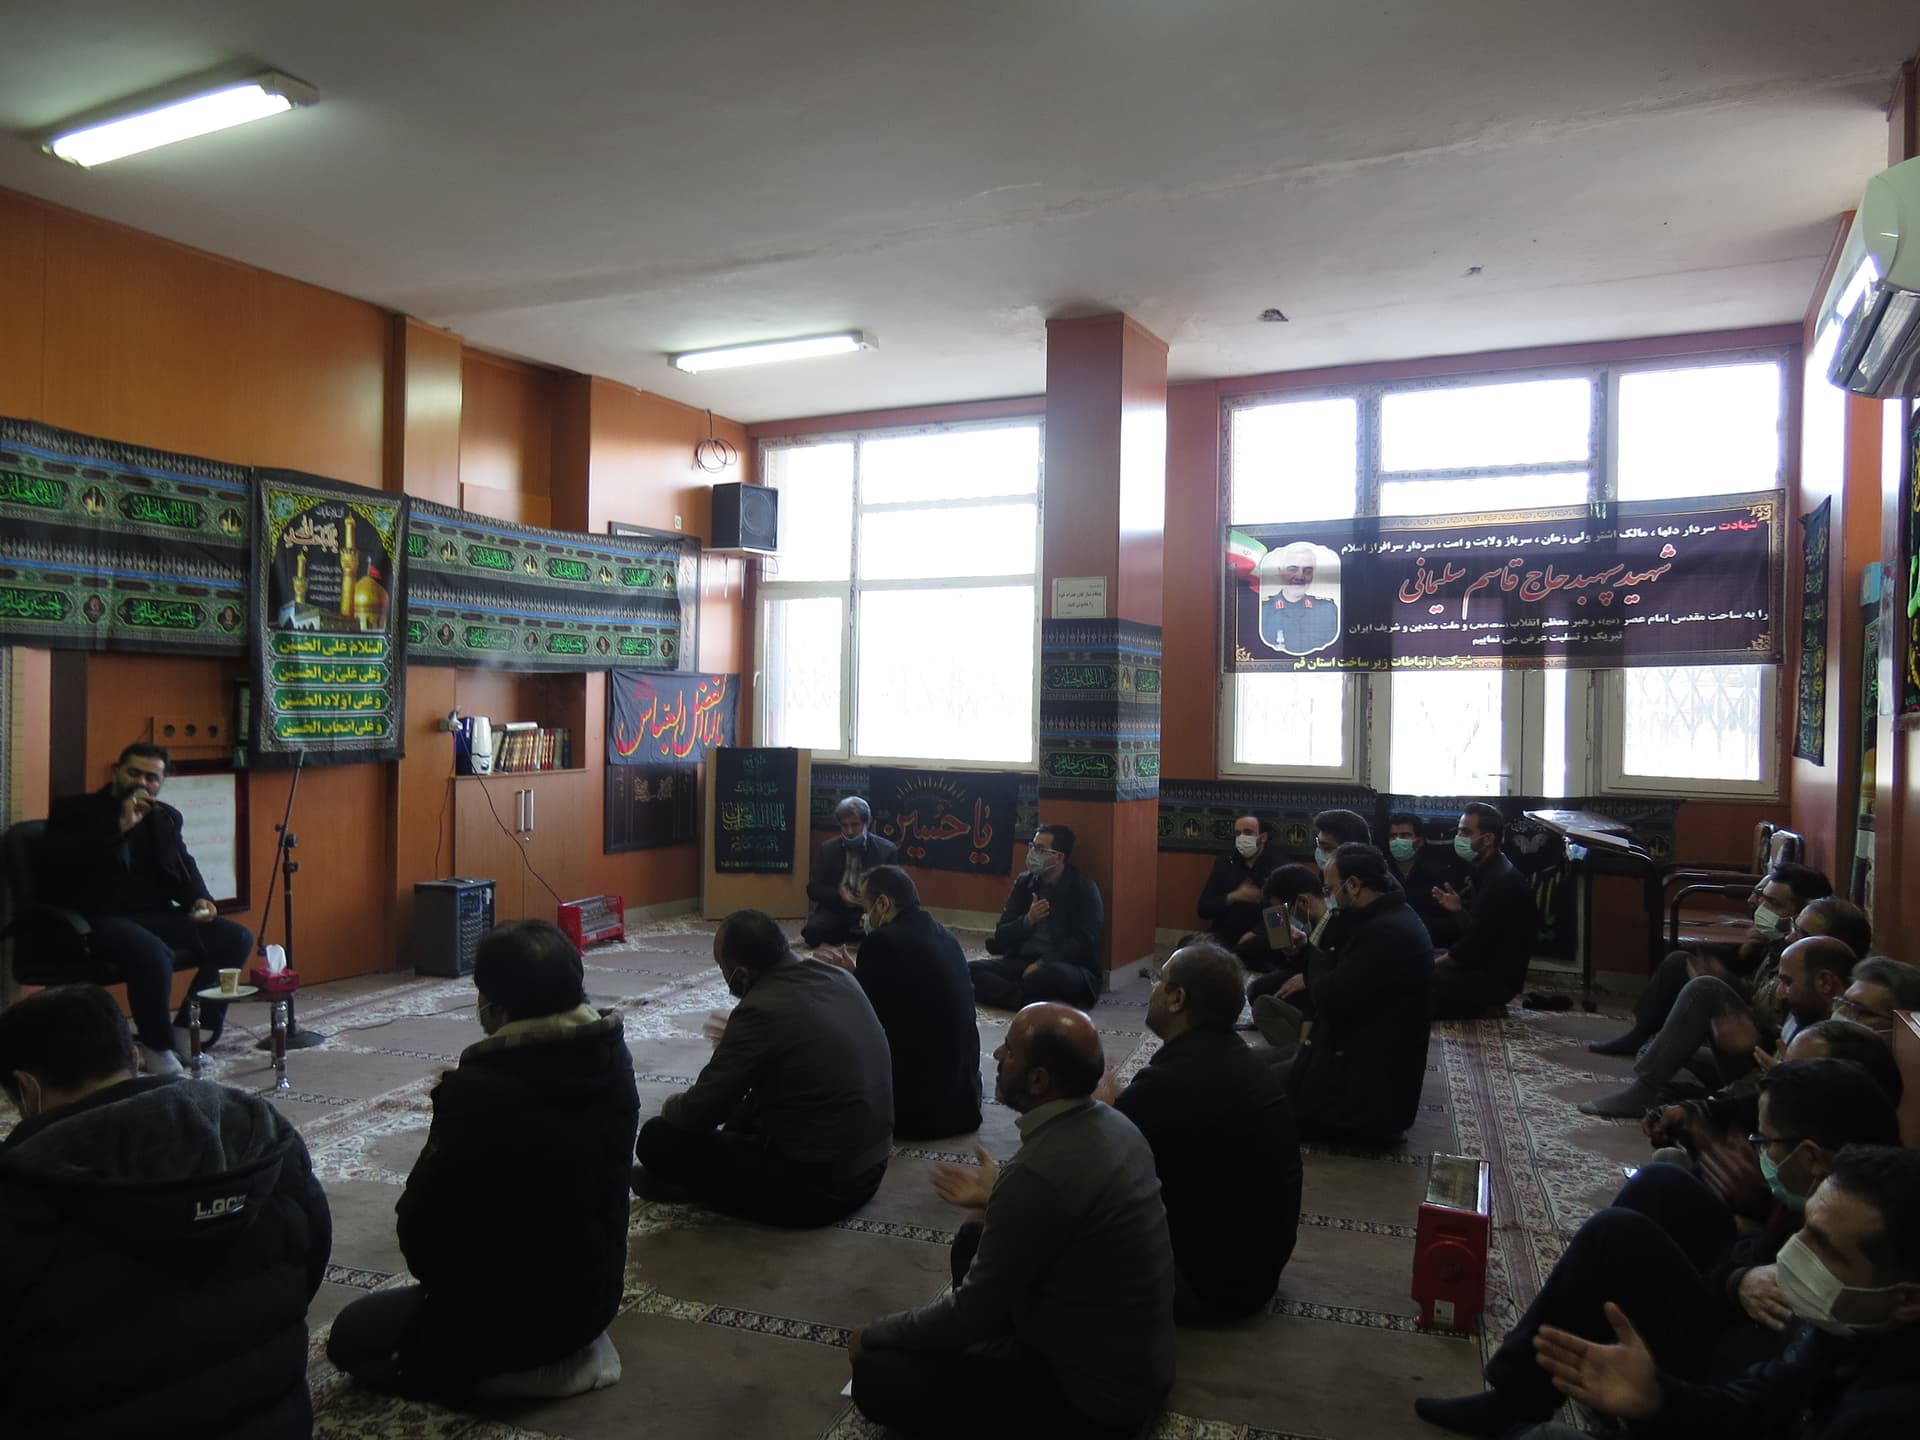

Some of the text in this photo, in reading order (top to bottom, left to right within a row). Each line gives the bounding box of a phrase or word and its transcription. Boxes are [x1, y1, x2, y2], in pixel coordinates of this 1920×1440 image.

[1682, 523, 1716, 537] سردار
[1718, 519, 1759, 531] شهادت
[1619, 528, 1648, 539] مالک
[1657, 526, 1680, 537] دلها
[1443, 539, 1463, 549] امت
[1473, 536, 1502, 547] ولایت
[1504, 534, 1533, 547] سرباز
[1541, 532, 1568, 545] زمان
[1341, 544, 1367, 554] اسلام
[1406, 541, 1435, 553] سردار
[1398, 544, 1676, 620] شهید سپهبد حاج قاسم سلیمانی
[1647, 614, 1669, 625] امام
[1671, 613, 1706, 625] مقدس
[1708, 610, 1742, 621] ساحت
[1744, 610, 1756, 620] به
[1758, 609, 1769, 621] را
[1510, 618, 1540, 629] انقلاب
[1541, 617, 1569, 627] معظم
[1623, 616, 1645, 626] عصر
[1349, 624, 1373, 634] ایران
[1373, 624, 1401, 634] شریف
[1410, 623, 1439, 633] متدین
[1439, 623, 1460, 631] ملت
[1520, 634, 1548, 646] عرض
[1549, 632, 1581, 643] تسلیت
[1591, 632, 1623, 642] تبریک
[1293, 657, 1306, 671] قم
[1307, 656, 1335, 670] استان
[1391, 656, 1436, 670] ارتباطات
[1439, 655, 1473, 668] شرکت
